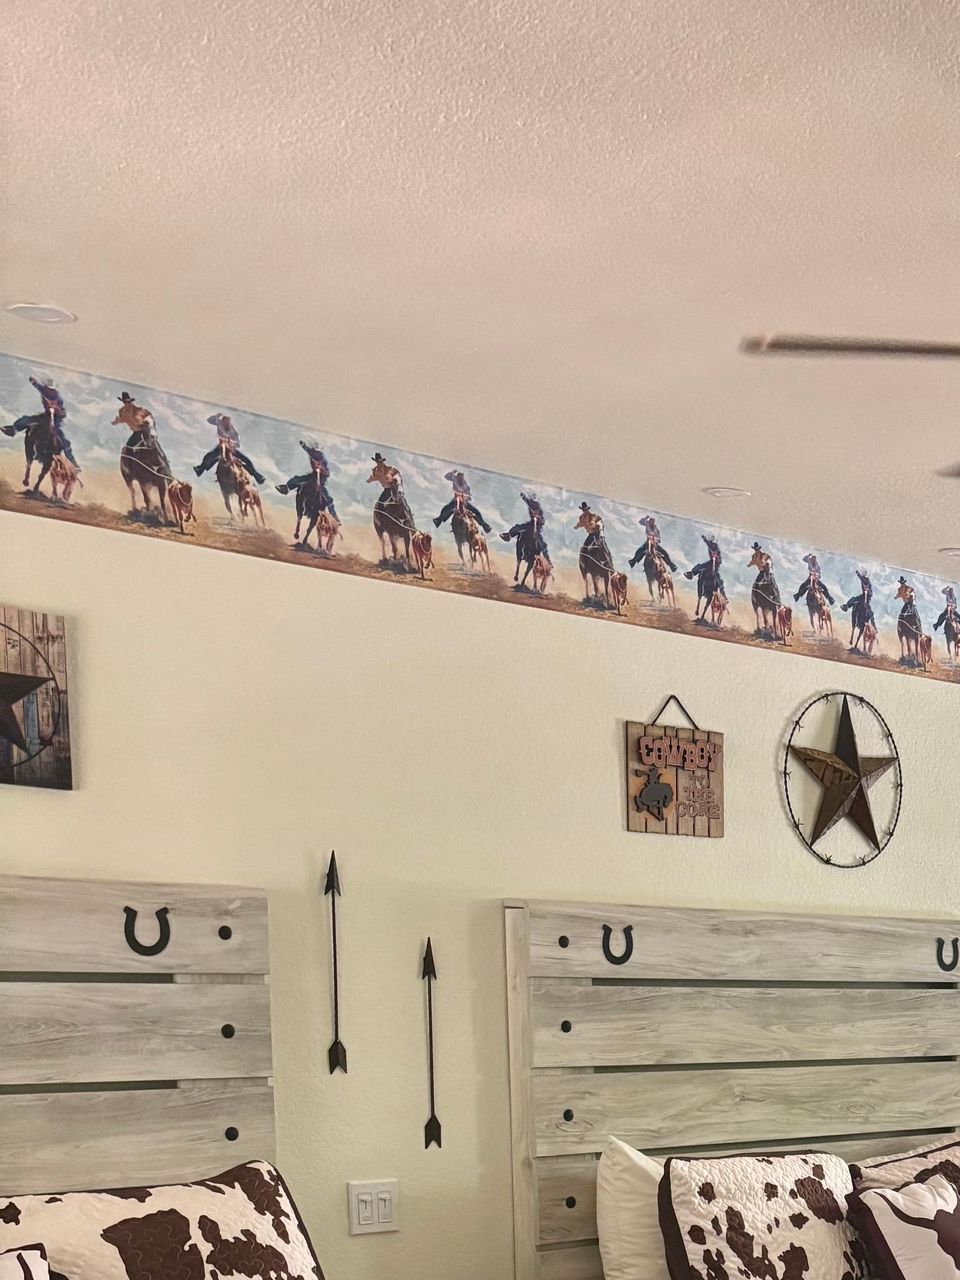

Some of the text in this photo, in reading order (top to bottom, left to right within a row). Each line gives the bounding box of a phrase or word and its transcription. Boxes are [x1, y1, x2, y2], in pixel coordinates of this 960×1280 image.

[638, 735, 719, 772] COWBOY
[688, 773, 710, 789] TO
[684, 787, 715, 804] THE
[676, 801, 720, 820] CORE
